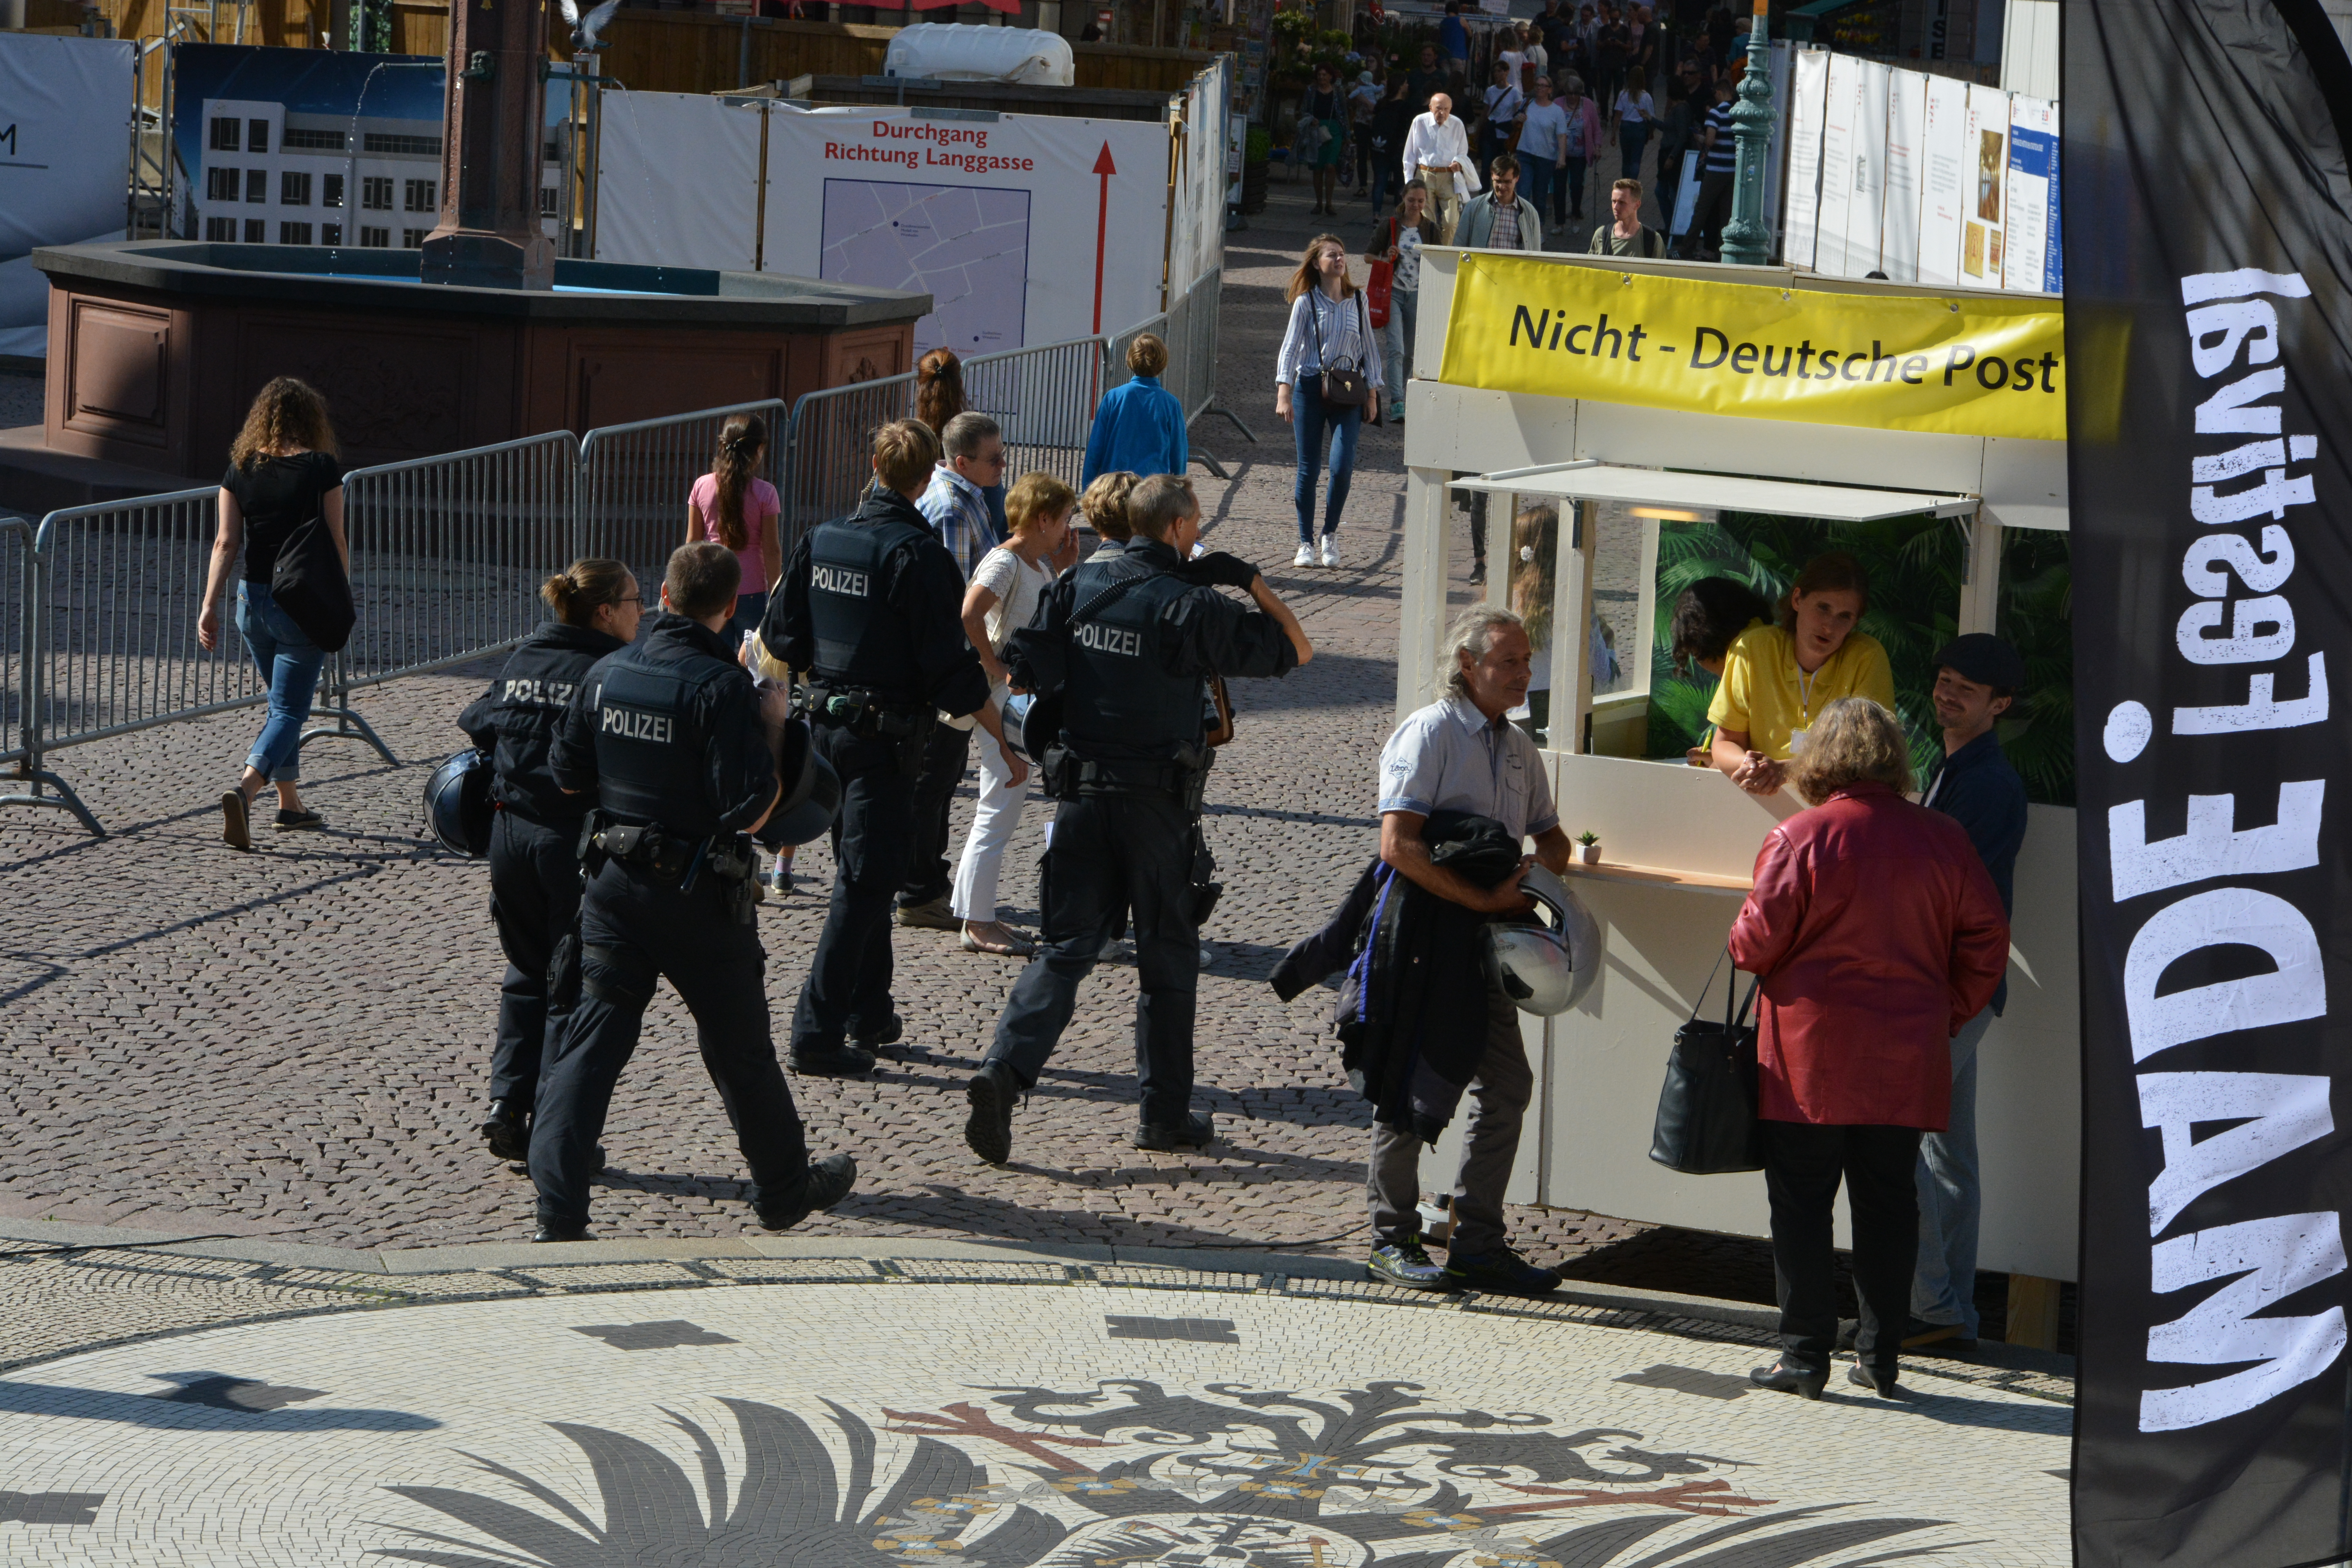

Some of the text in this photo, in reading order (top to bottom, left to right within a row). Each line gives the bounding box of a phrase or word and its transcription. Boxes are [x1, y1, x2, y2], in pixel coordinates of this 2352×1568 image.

[873, 121, 987, 149] Durchgang
[825, 142, 1034, 173] Richtung Langgasse
[1509, 305, 1647, 362] Nicht
[1690, 327, 1928, 384] Deutsche
[1944, 345, 2059, 393] Post
[812, 565, 868, 597] POLIZEI
[1073, 621, 1141, 656] POLIZEI
[503, 679, 601, 711] POLIZI
[602, 707, 672, 743] POLIZEI
